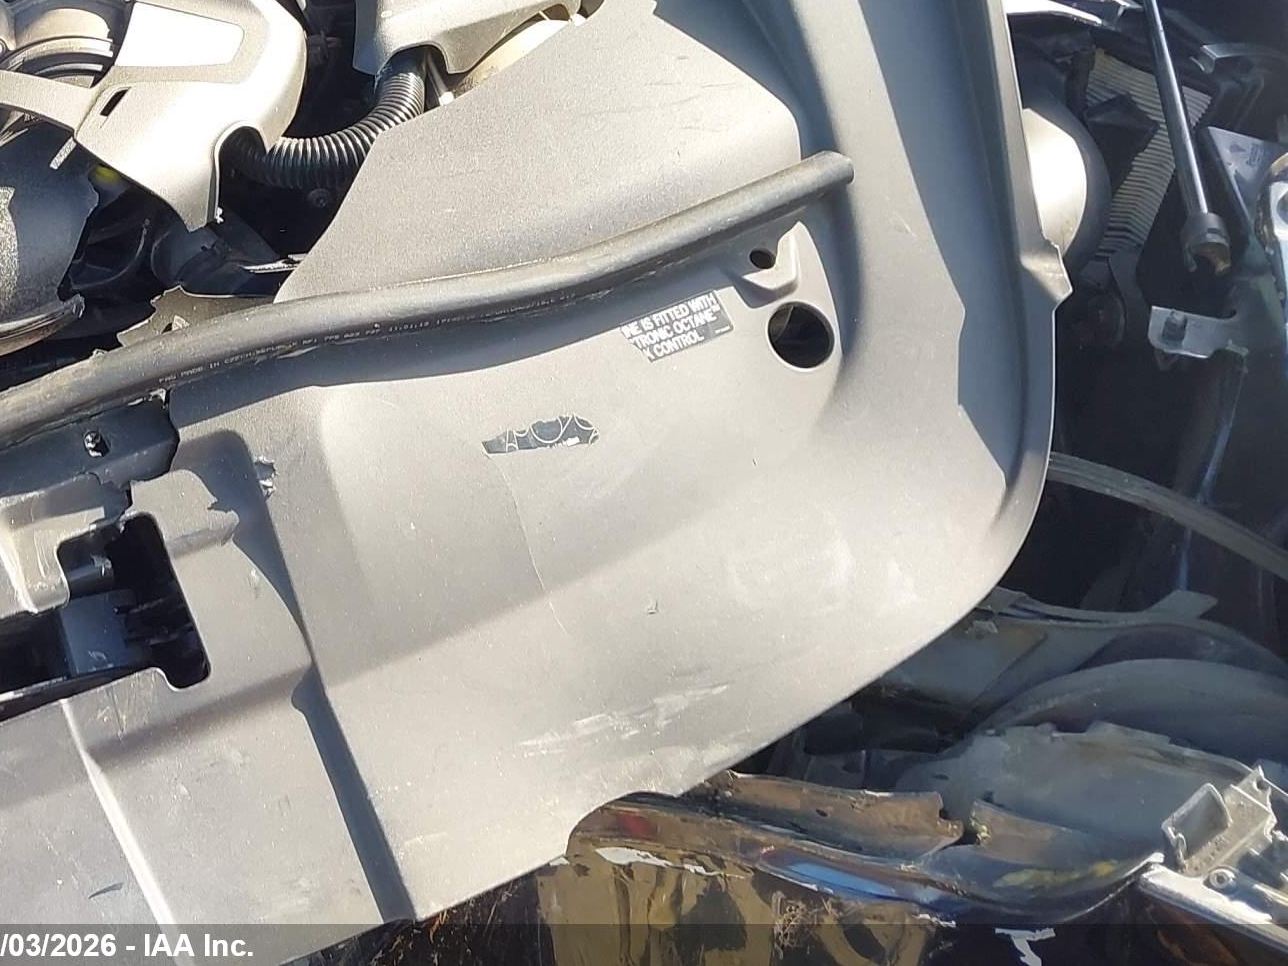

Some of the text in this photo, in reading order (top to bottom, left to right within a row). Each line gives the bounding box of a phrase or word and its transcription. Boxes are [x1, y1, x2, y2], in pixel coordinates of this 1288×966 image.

[641, 316, 654, 331] IS
[653, 303, 690, 327] FITTED
[687, 292, 717, 314] WITH
[653, 329, 705, 357] CONTROL
